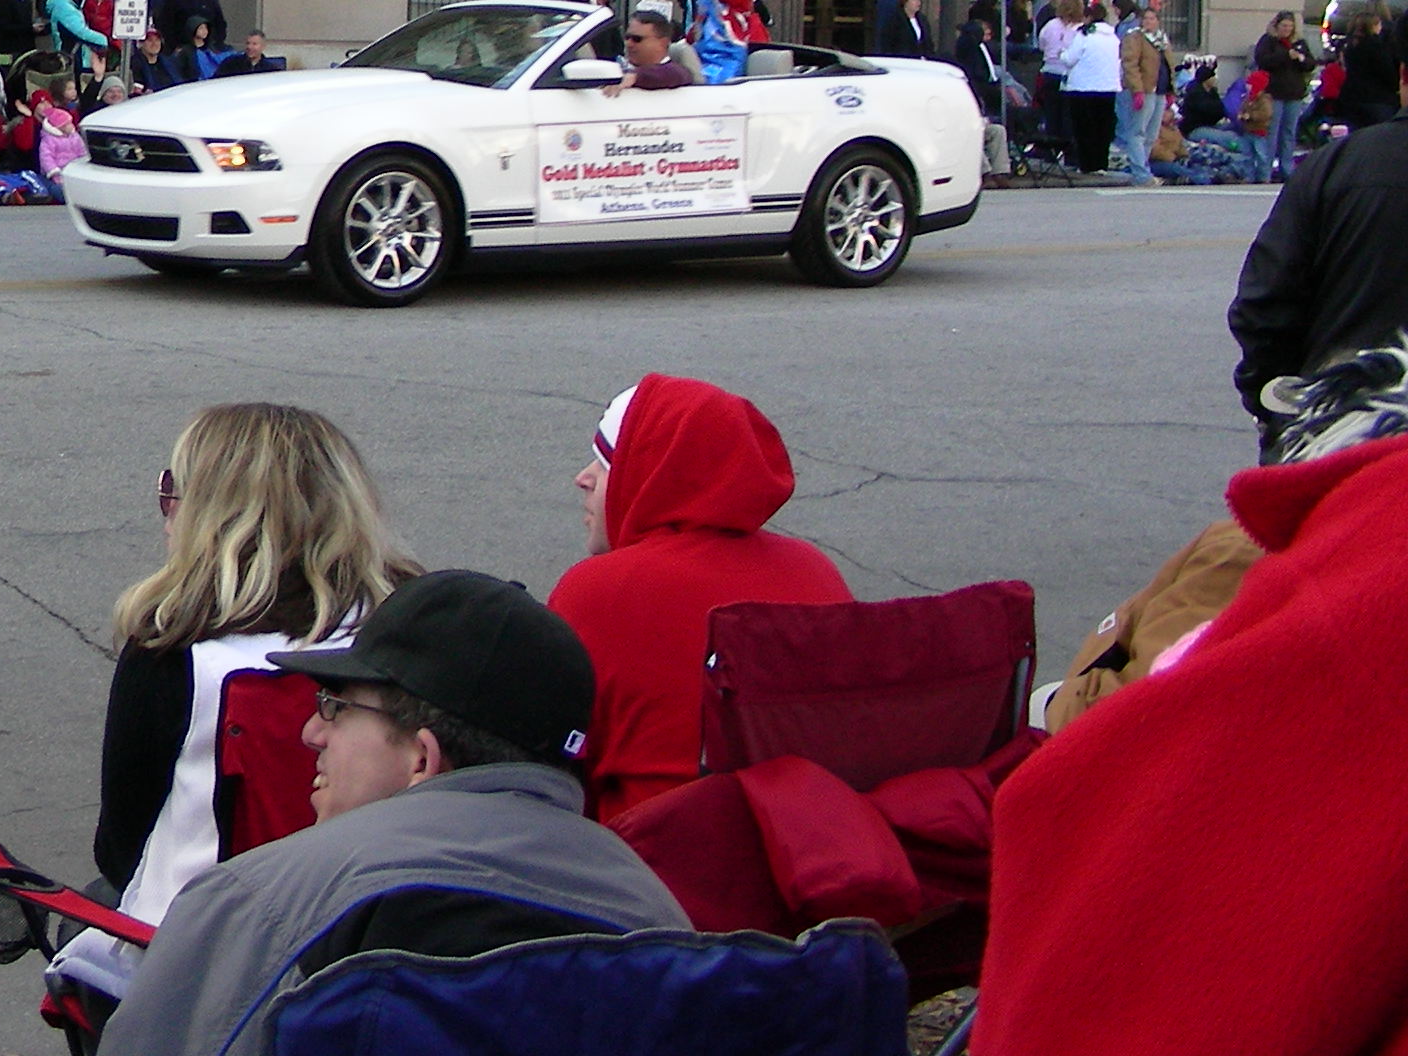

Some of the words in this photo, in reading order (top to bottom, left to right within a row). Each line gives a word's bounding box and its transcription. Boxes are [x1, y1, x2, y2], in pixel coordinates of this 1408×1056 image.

[617, 123, 671, 138] Monica
[605, 140, 685, 157] Hernandez
[542, 163, 578, 182] Gold
[656, 154, 739, 177] Gymnastics
[652, 198, 693, 210] Greece
